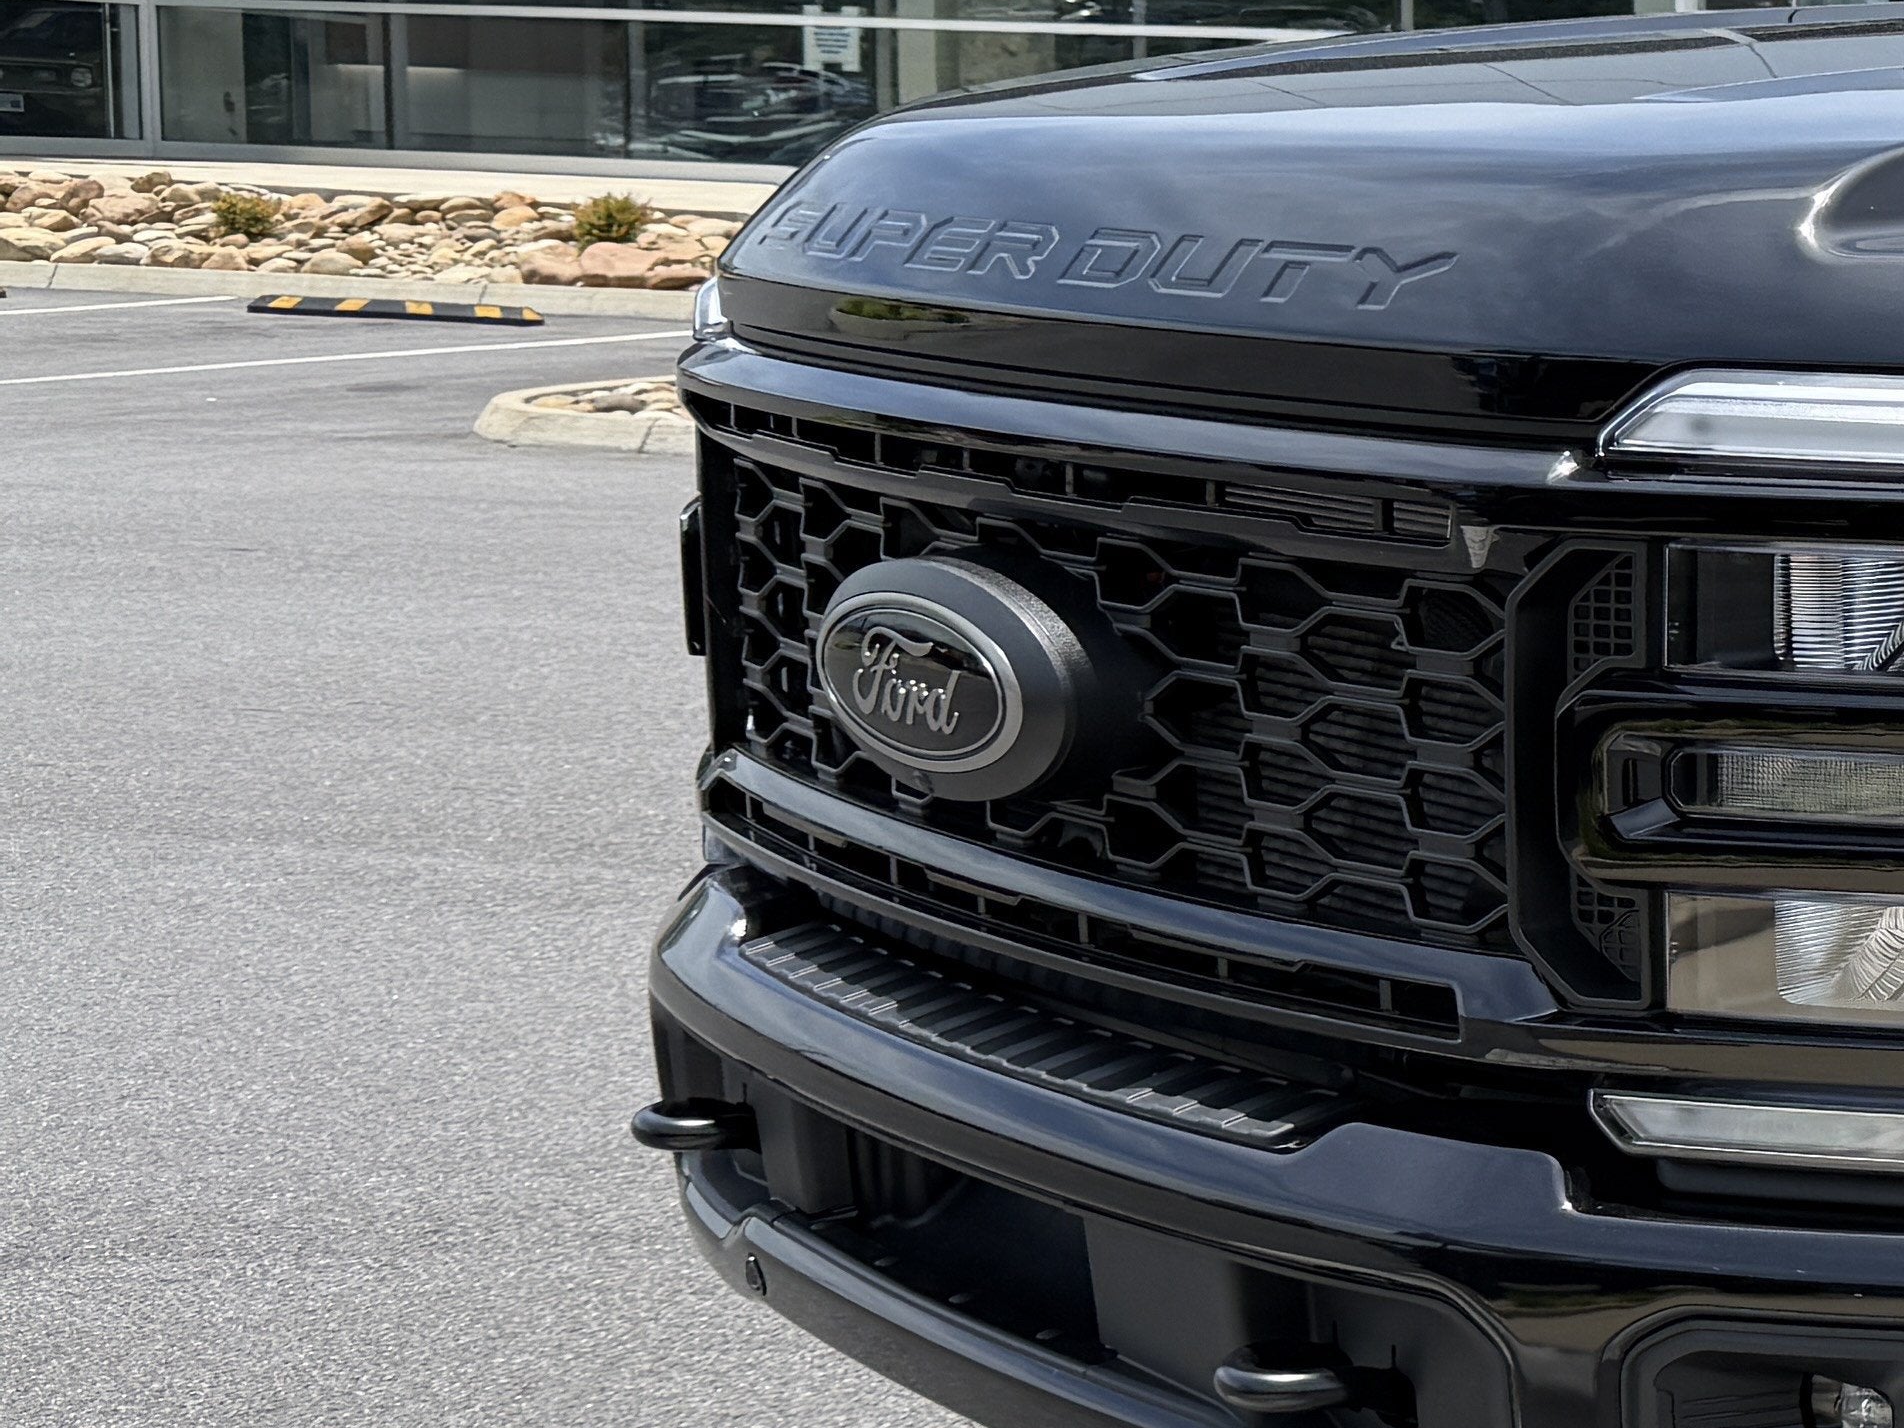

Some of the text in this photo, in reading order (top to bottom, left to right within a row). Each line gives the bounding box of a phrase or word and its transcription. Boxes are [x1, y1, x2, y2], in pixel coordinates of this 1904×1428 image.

[762, 199, 1459, 312] SUPER DUTY
[852, 626, 959, 735] Ford
